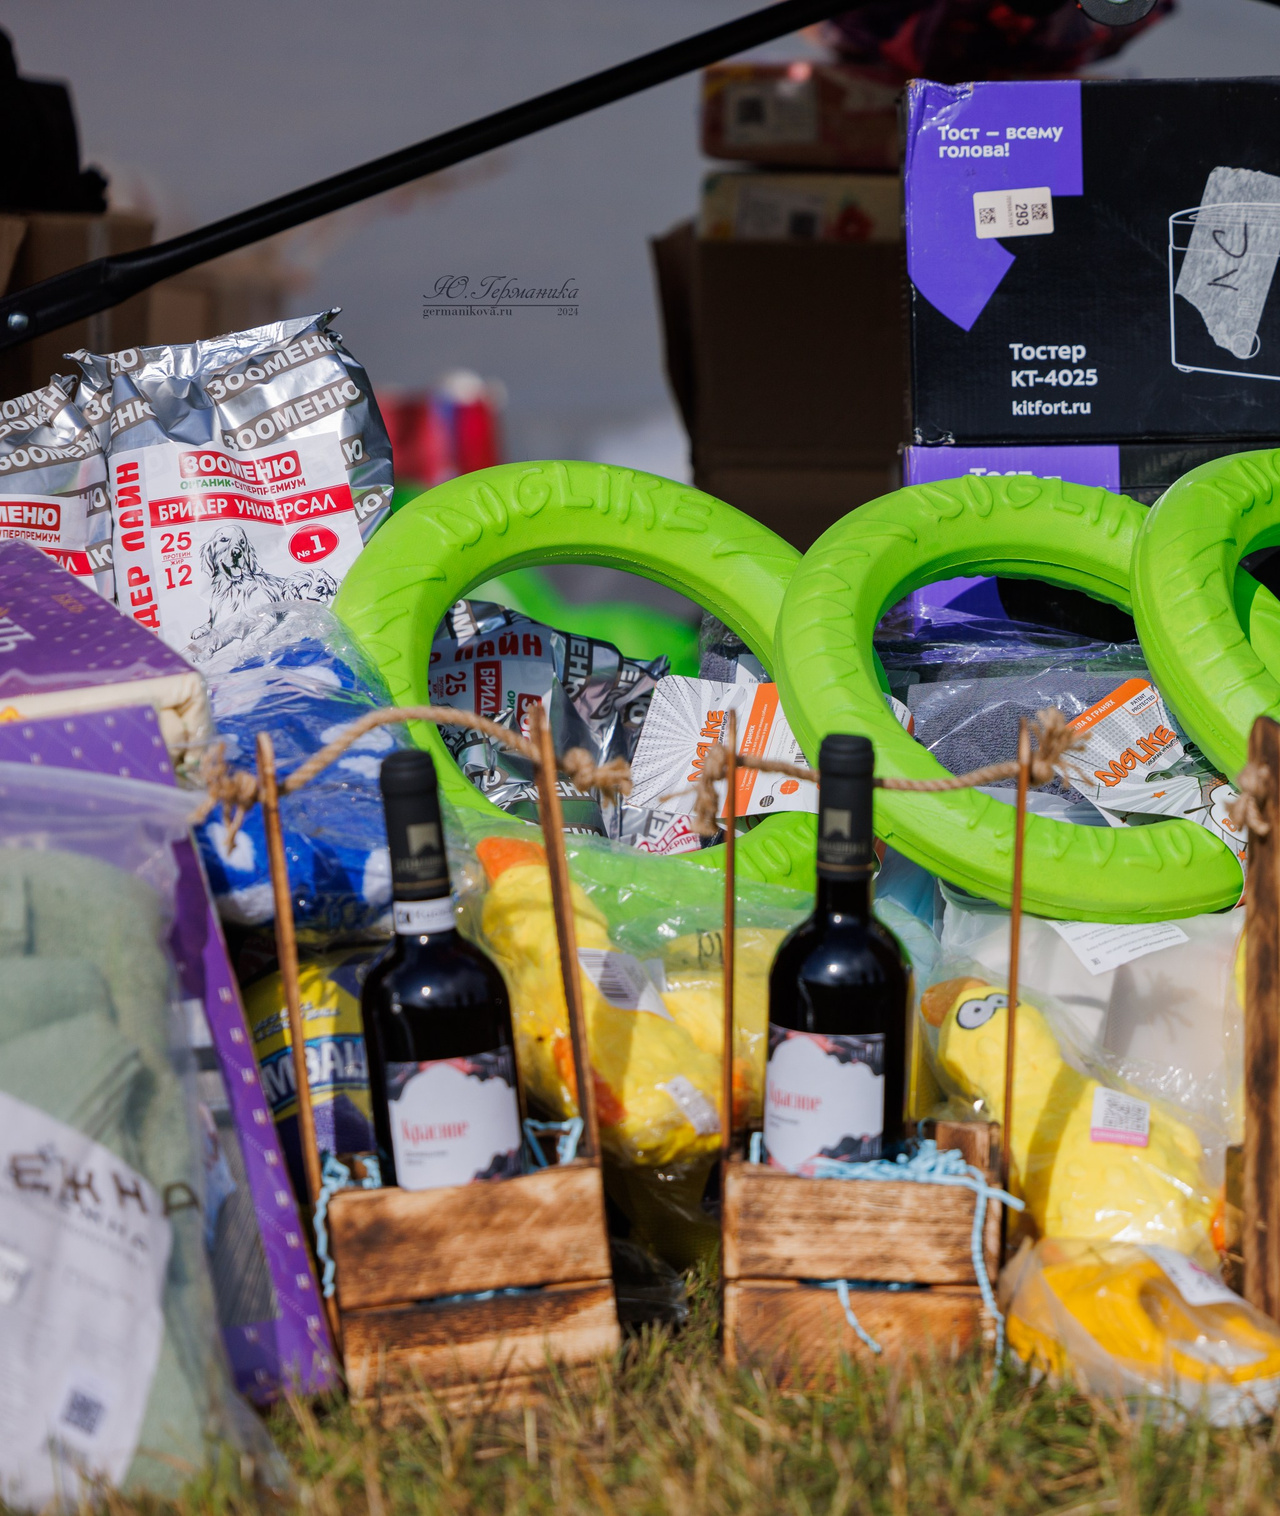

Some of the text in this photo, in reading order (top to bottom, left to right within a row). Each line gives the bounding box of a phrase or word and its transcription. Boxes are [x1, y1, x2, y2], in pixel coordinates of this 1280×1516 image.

[938, 126, 980, 142] Тост
[1006, 125, 1064, 144] всему
[938, 142, 1011, 160] голова!
[1015, 203, 1030, 226] 293
[1009, 342, 1087, 364] Тостер
[1010, 369, 1099, 387] KT-4025
[1011, 399, 1092, 416] kitfort.ru
[181, 454, 298, 481] ЗООМЕНЮ
[116, 461, 147, 553] ЛАЙН
[158, 493, 337, 522] БРИДЕР УНИВЕРСАЛ
[160, 531, 193, 554] 25
[164, 564, 193, 590] 12
[445, 671, 467, 696] 25
[1090, 697, 1115, 719] ГРАНЯХ
[1130, 692, 1146, 706] PATENT
[1131, 693, 1155, 714] PROTECTED
[1094, 724, 1177, 790] DOGLIKE
